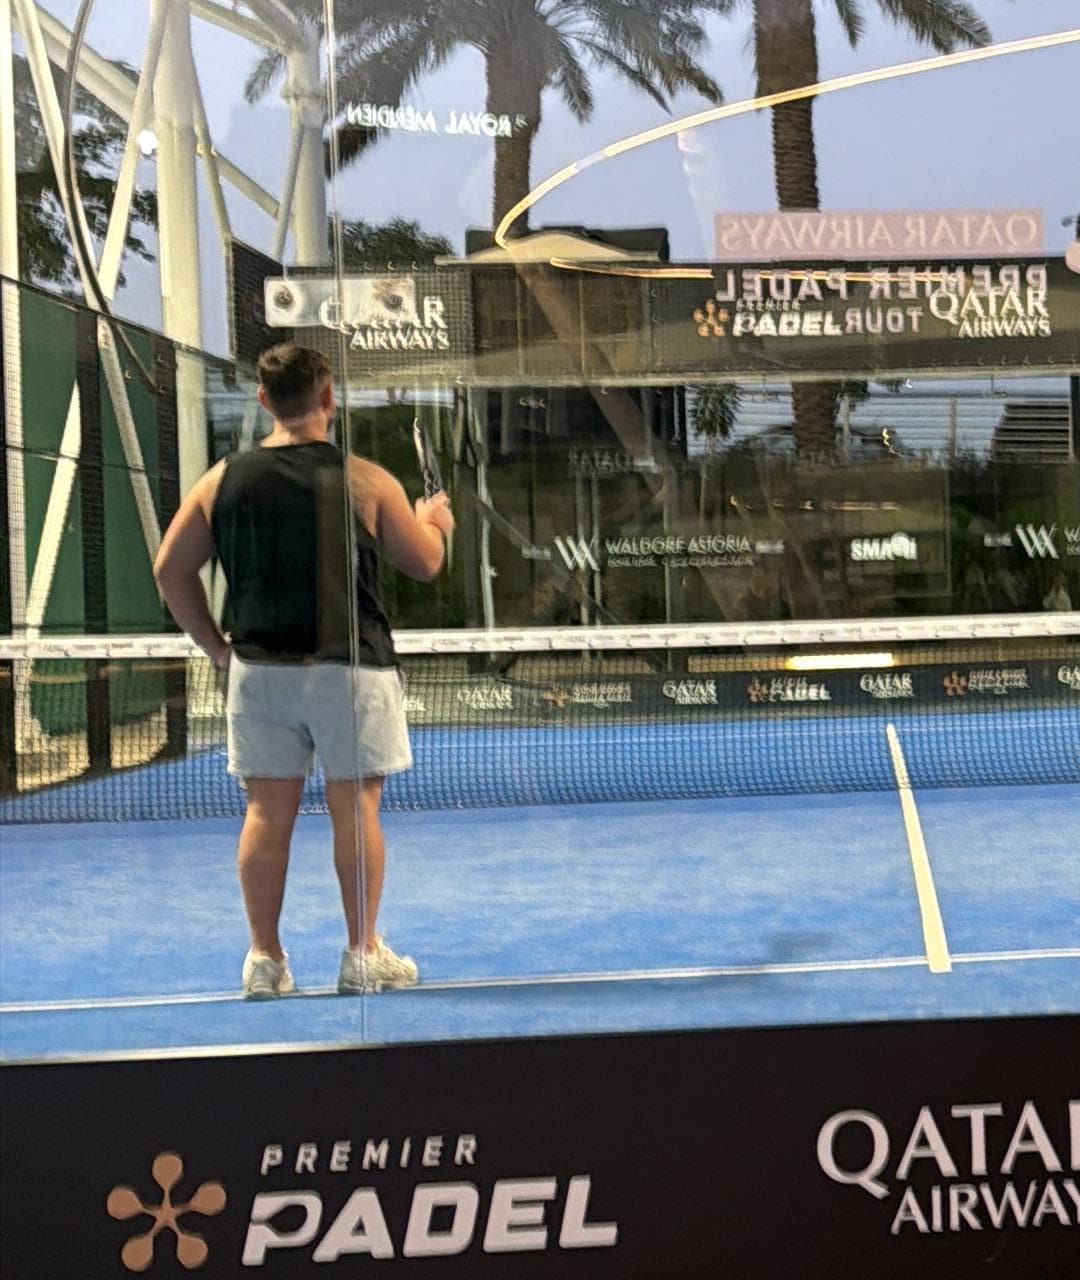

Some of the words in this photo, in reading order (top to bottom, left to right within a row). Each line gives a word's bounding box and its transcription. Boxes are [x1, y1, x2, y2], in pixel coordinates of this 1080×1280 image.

[929, 285, 1050, 325] QATAR
[732, 310, 843, 337] PADEL
[958, 316, 1052, 338] AIRWAYS
[350, 327, 450, 351] AIRWAYS
[687, 533, 751, 554] ASTORIA
[260, 1133, 480, 1176] PREMIER
[240, 1175, 620, 1268] PADEL
